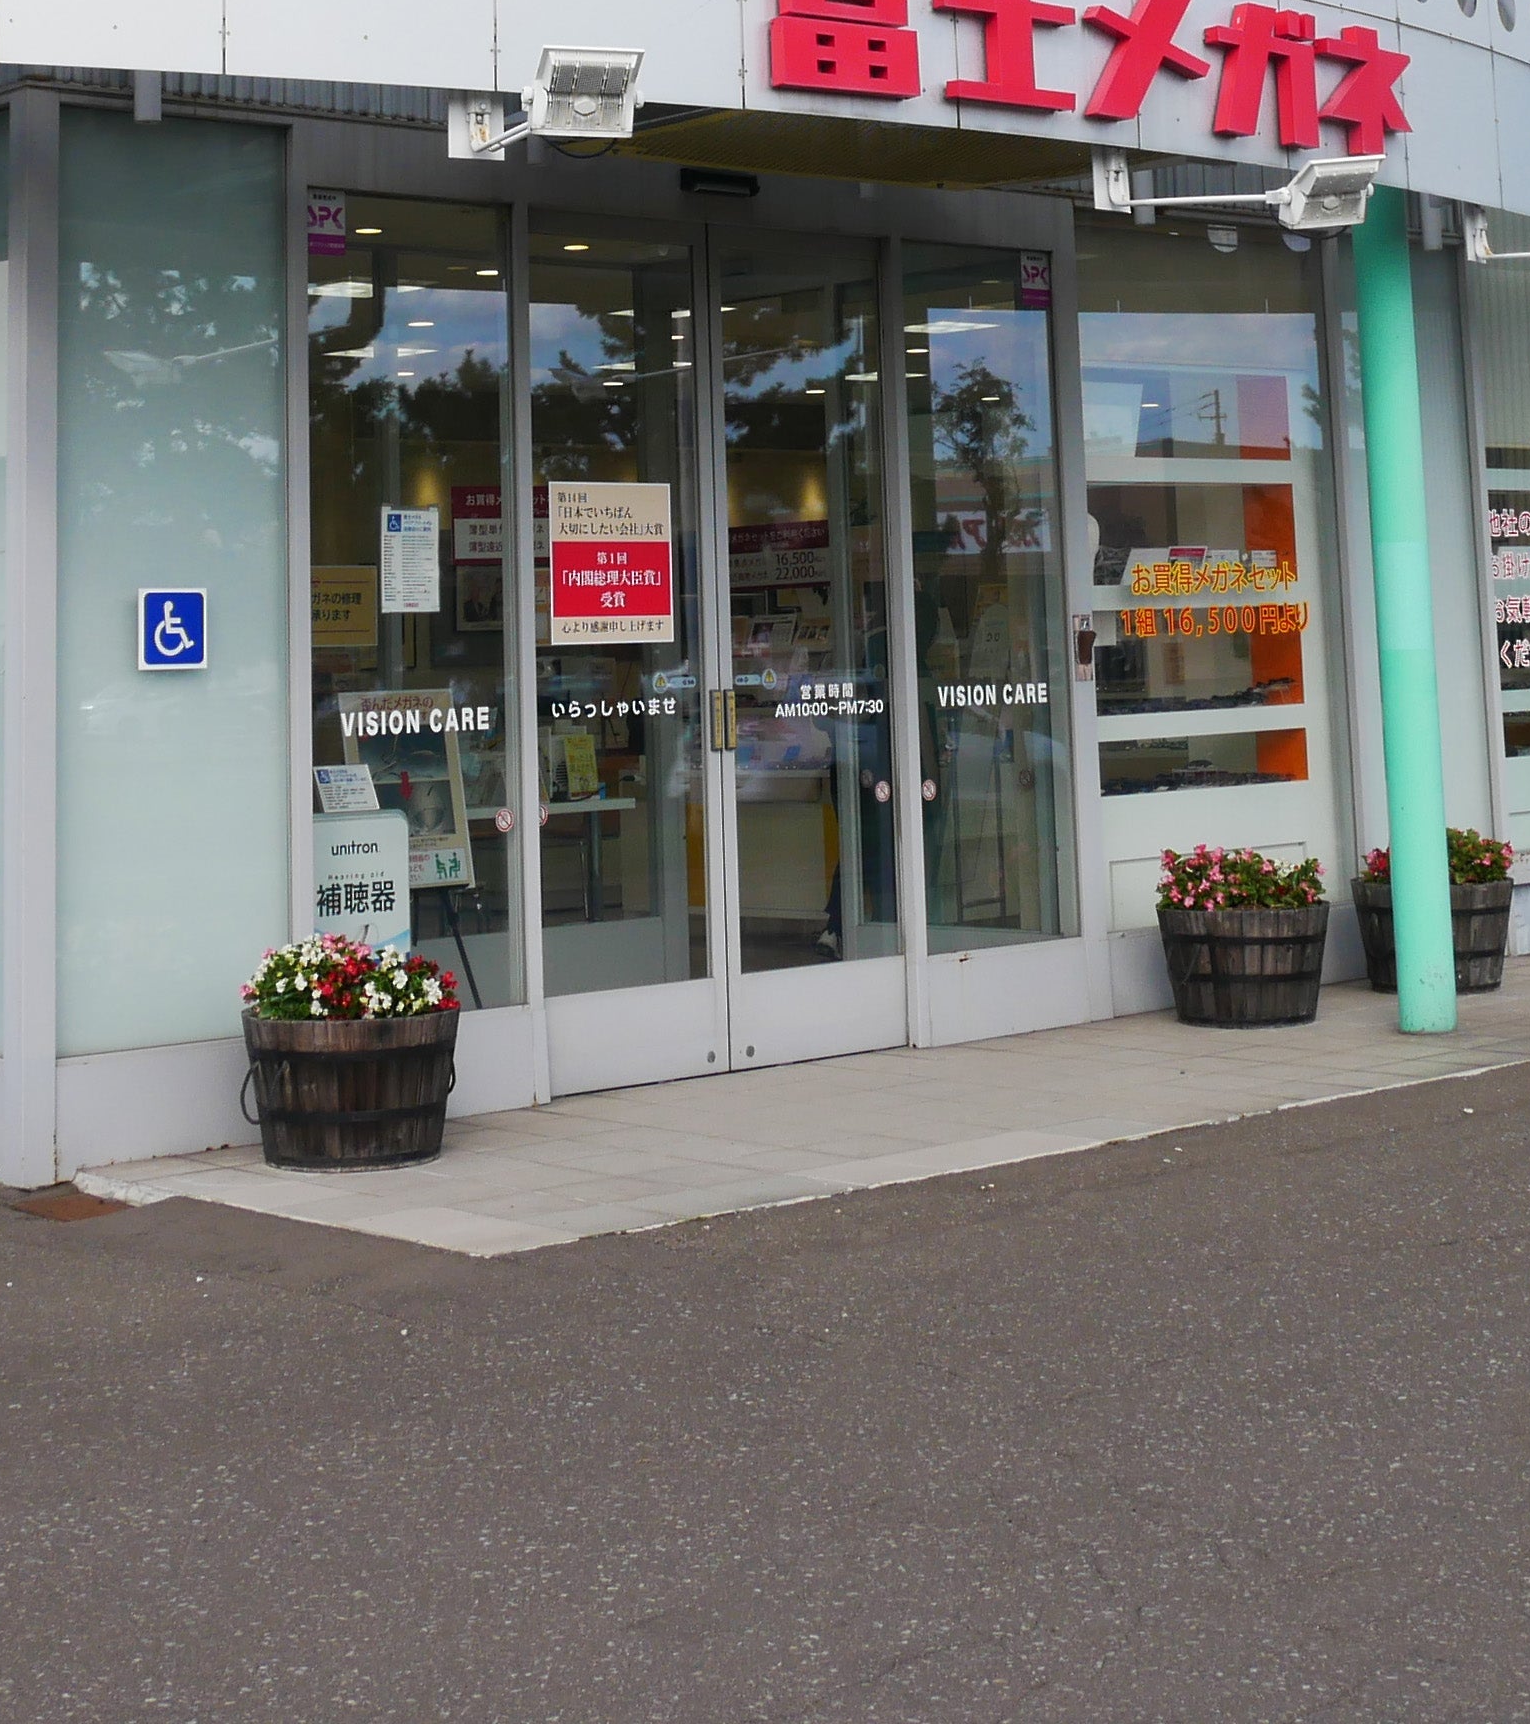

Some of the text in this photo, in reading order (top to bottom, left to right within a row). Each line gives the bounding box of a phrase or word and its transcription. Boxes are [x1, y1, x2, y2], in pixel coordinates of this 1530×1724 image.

[596, 551, 628, 565] 第1回
[562, 569, 662, 587] 「内閣総理大臣賞」
[1131, 561, 1298, 595] お買得メガネセット
[600, 591, 626, 608] 受賞
[799, 683, 854, 700] 営業時間
[937, 682, 1048, 708] VISION CARE
[551, 697, 677, 718] いらっしゃいませ
[341, 709, 420, 737] VISION
[429, 706, 490, 733] CARE
[331, 840, 379, 856] unitron
[316, 880, 396, 918] 補聴器
